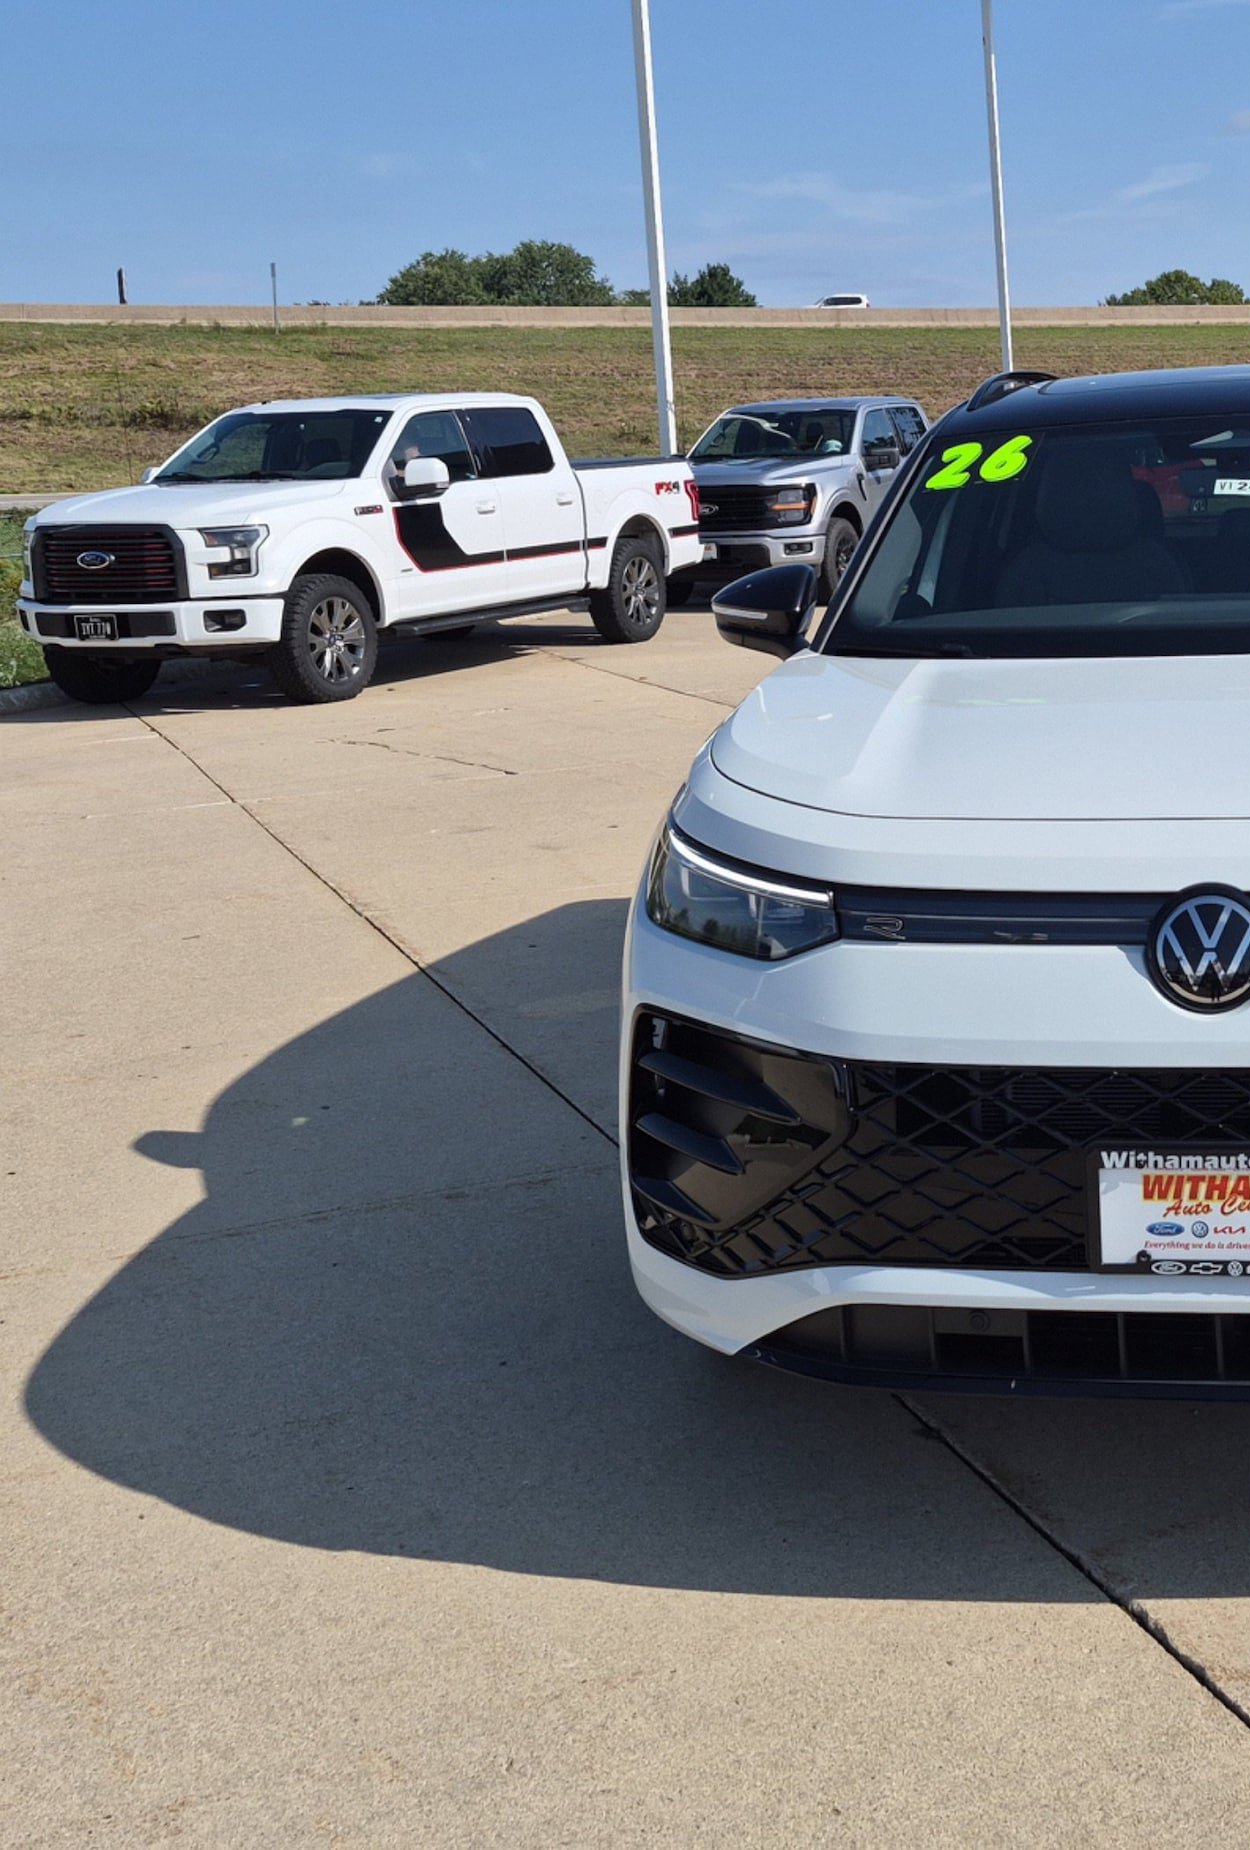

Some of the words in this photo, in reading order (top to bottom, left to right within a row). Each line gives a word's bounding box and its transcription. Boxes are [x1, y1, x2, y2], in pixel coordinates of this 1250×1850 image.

[925, 435, 1032, 490] 26
[655, 481, 680, 495] FX4
[1163, 1200, 1213, 1217] Auto
[1145, 1241, 1189, 1250] Everything
[1205, 1241, 1216, 1249] do
